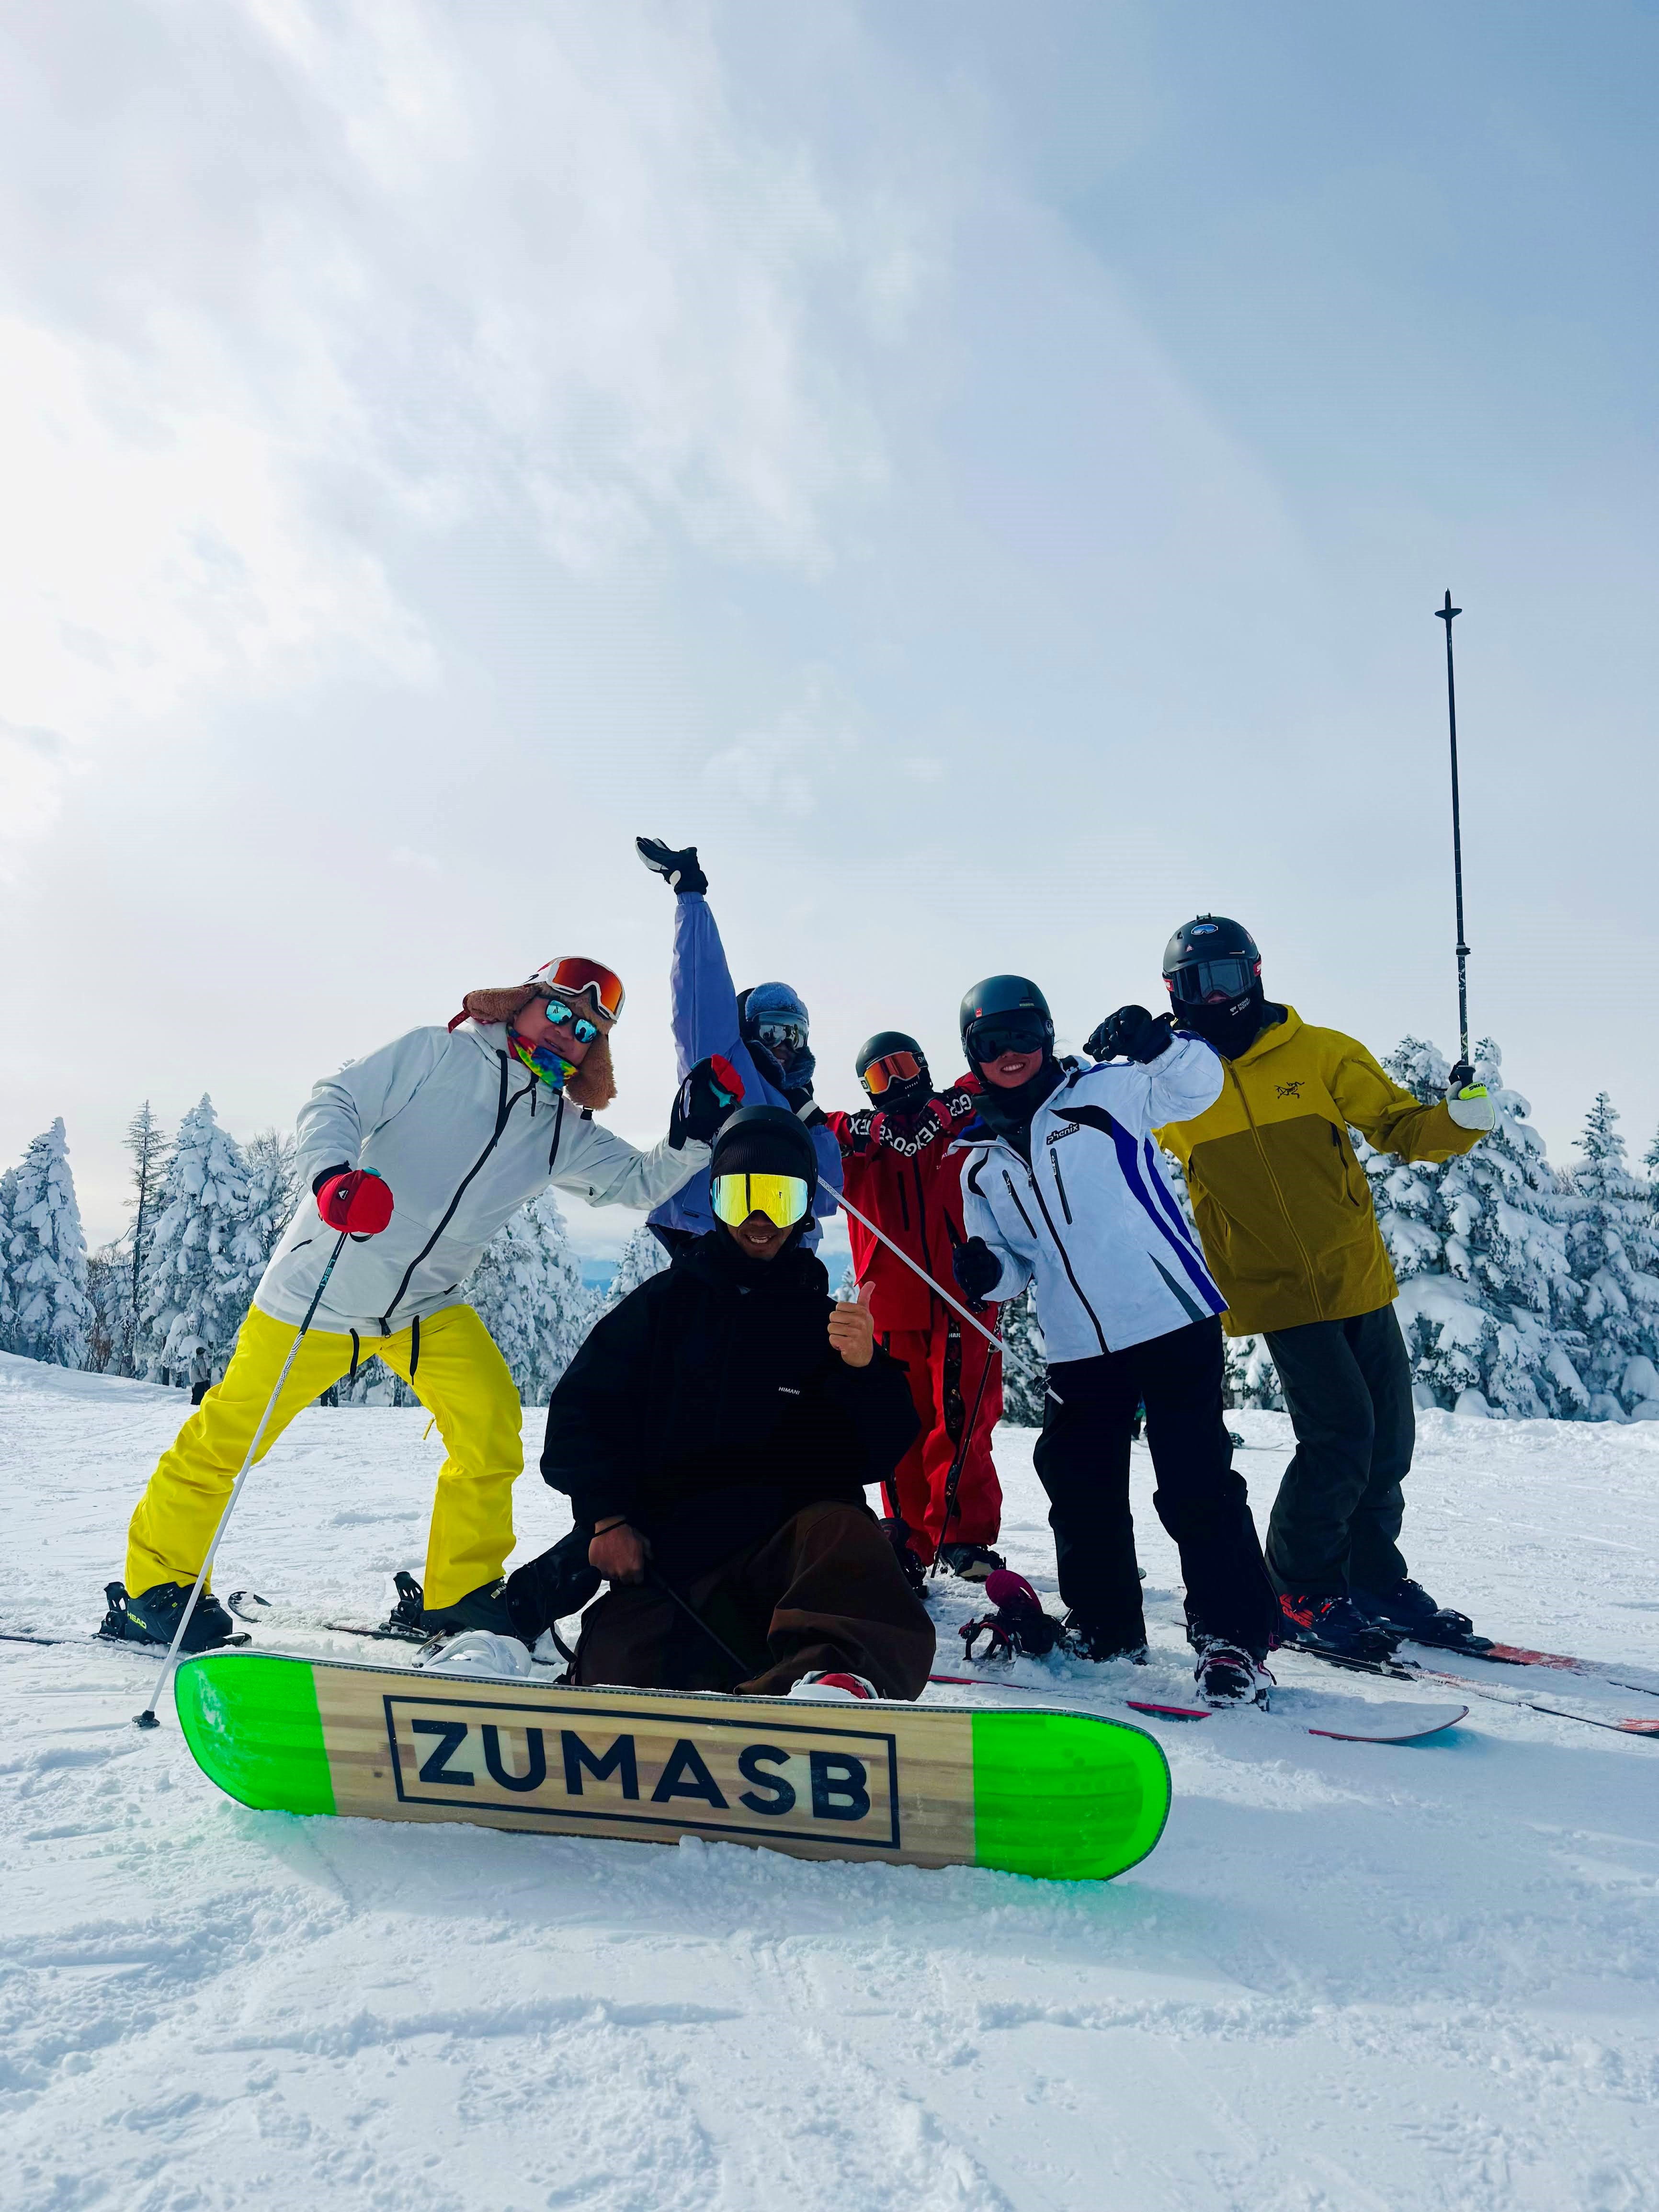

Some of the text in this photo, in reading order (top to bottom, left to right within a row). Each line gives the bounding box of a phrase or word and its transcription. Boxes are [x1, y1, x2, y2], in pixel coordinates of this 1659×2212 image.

[1047, 1124, 1079, 1144] phenix
[320, 1258, 336, 1287] LEKI
[127, 1610, 147, 1630] HEAD
[411, 1719, 872, 1822] ZUMASB
